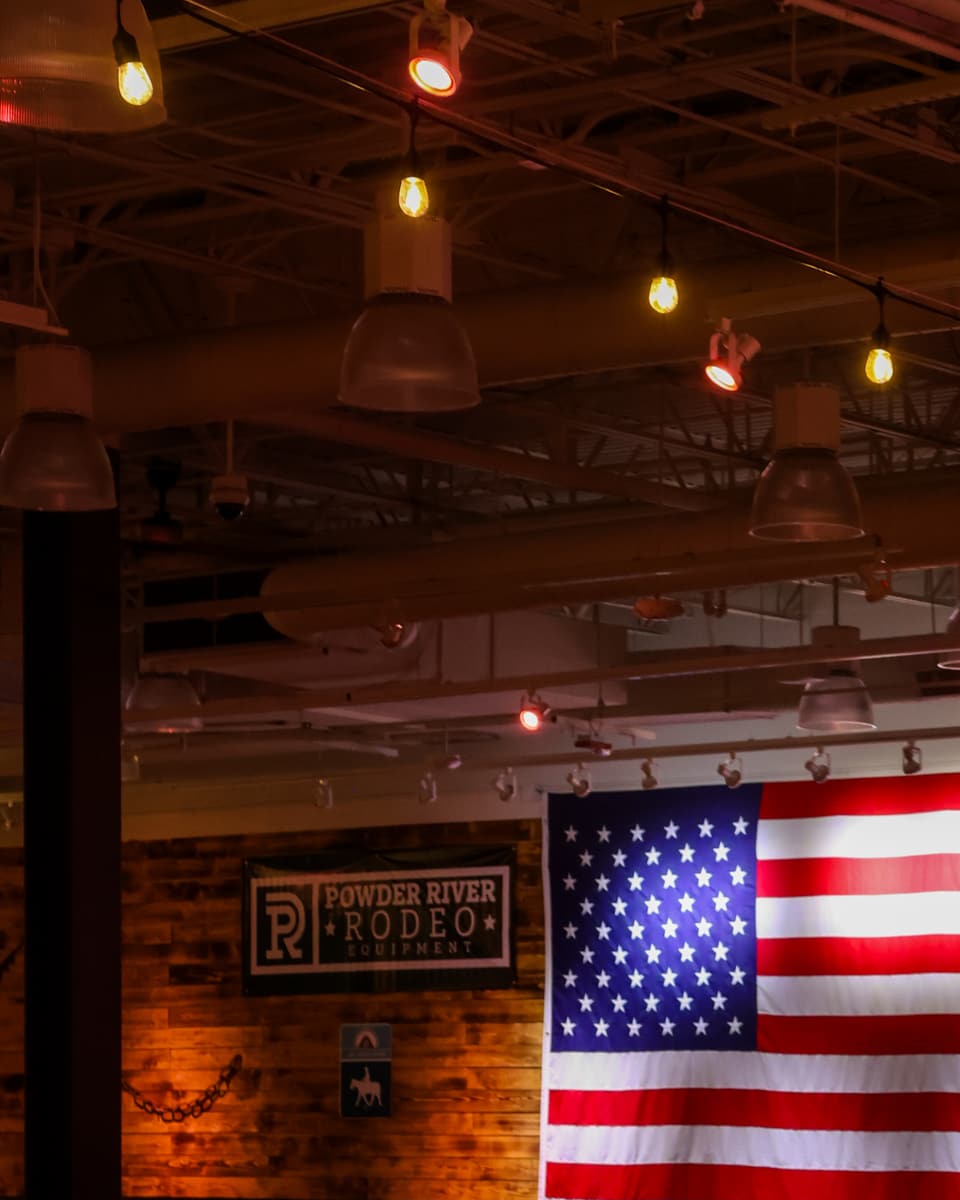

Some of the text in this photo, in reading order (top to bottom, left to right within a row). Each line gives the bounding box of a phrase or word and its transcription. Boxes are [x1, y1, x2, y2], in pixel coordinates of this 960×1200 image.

[324, 879, 496, 909] POWDER RIVER
[344, 906, 476, 941] RODEO
[348, 940, 472, 956] EQUIPMENT
